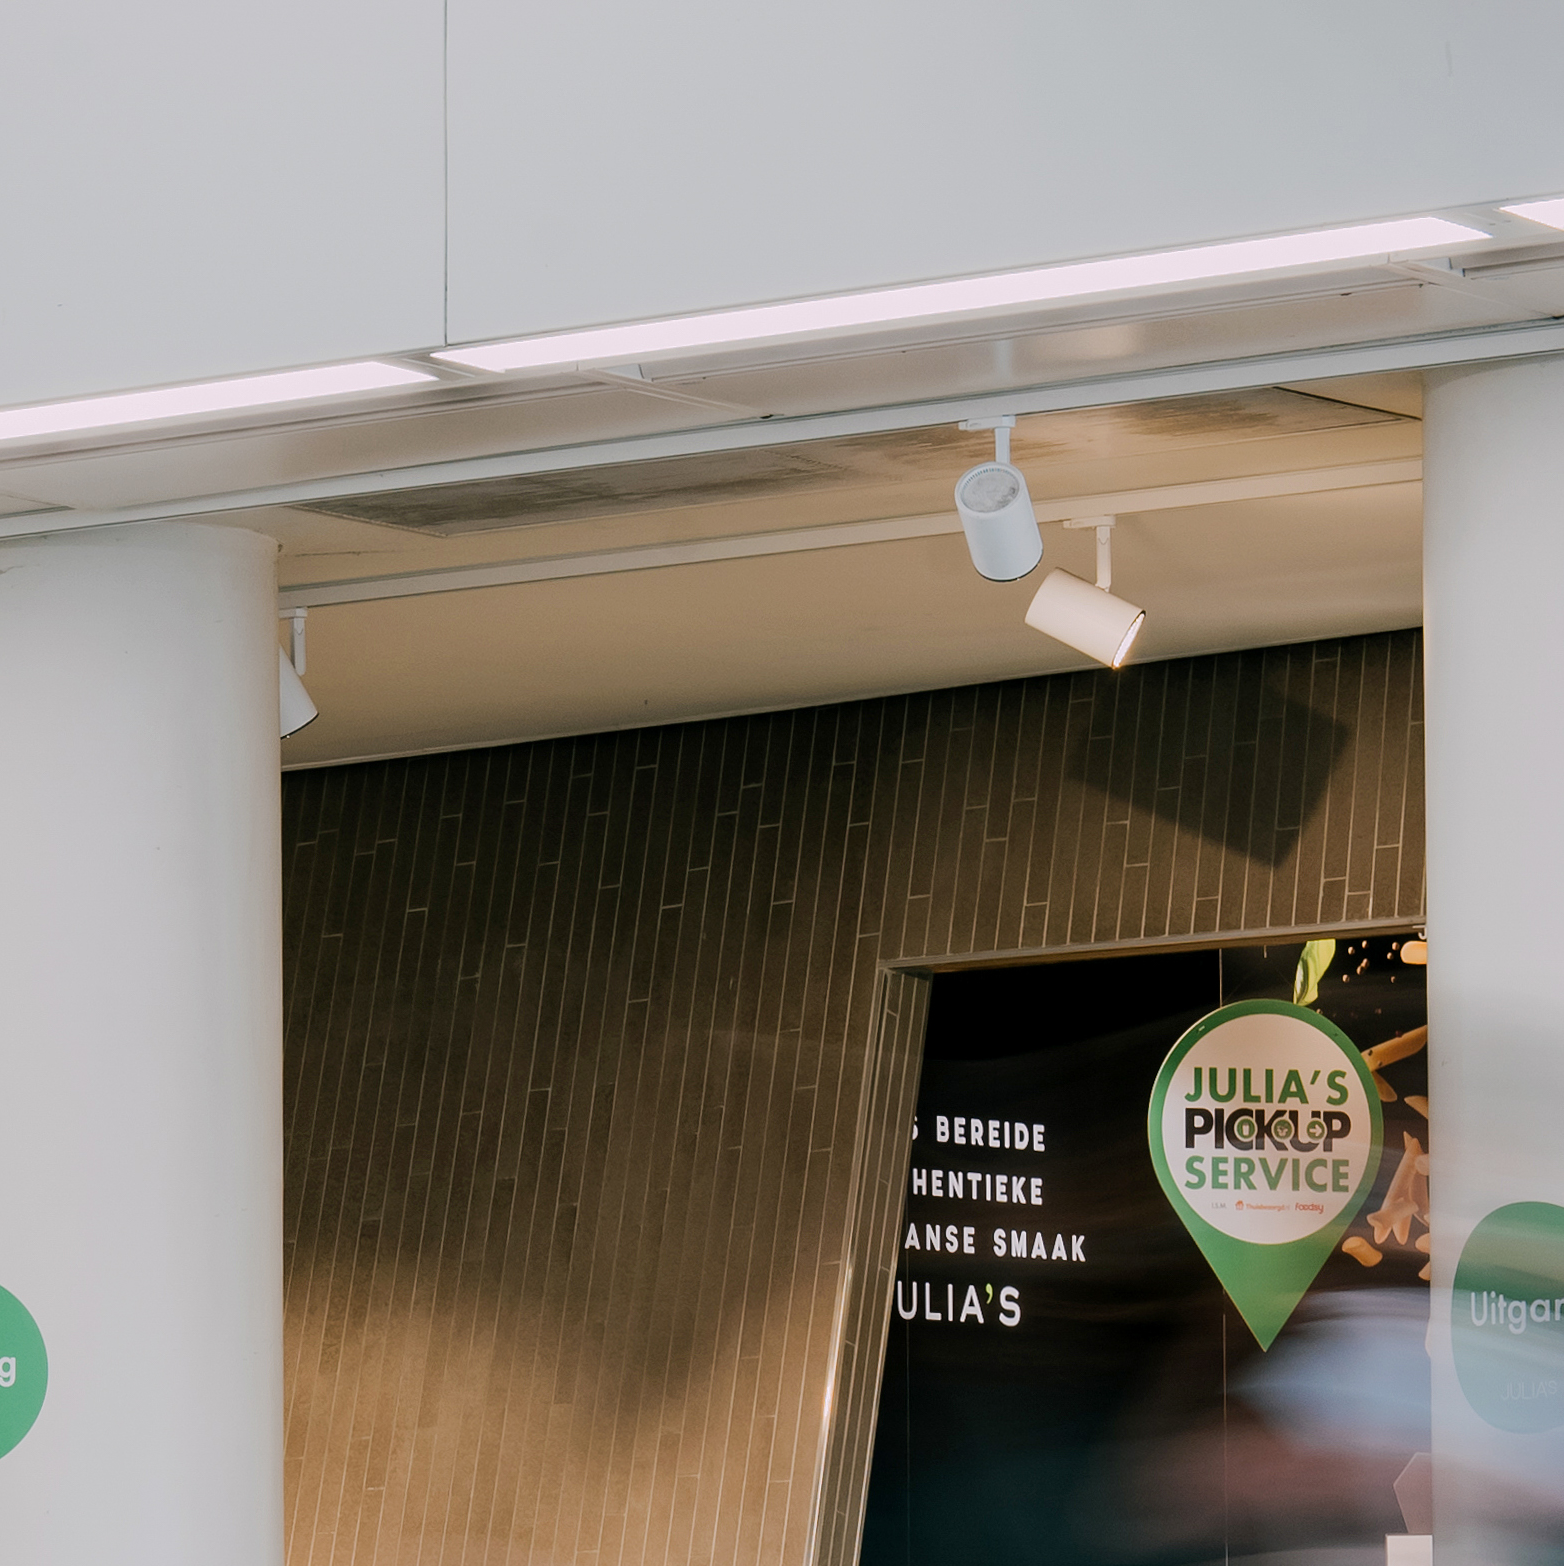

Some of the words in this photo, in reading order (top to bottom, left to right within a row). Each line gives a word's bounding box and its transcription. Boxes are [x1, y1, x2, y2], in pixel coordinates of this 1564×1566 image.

[1184, 1066, 1350, 1106] JULIA'S
[936, 1115, 1046, 1152] BEREIDE
[1184, 1107, 1352, 1153] PICKUP
[912, 1167, 1044, 1206] HENTIEKE
[1184, 1155, 1350, 1193] SERVICE
[904, 1222, 976, 1254] ANSE
[992, 1228, 1087, 1263] SMAAK
[897, 1280, 1022, 1328] ULIA'S
[1500, 1380, 1558, 1401] JULIA'S
